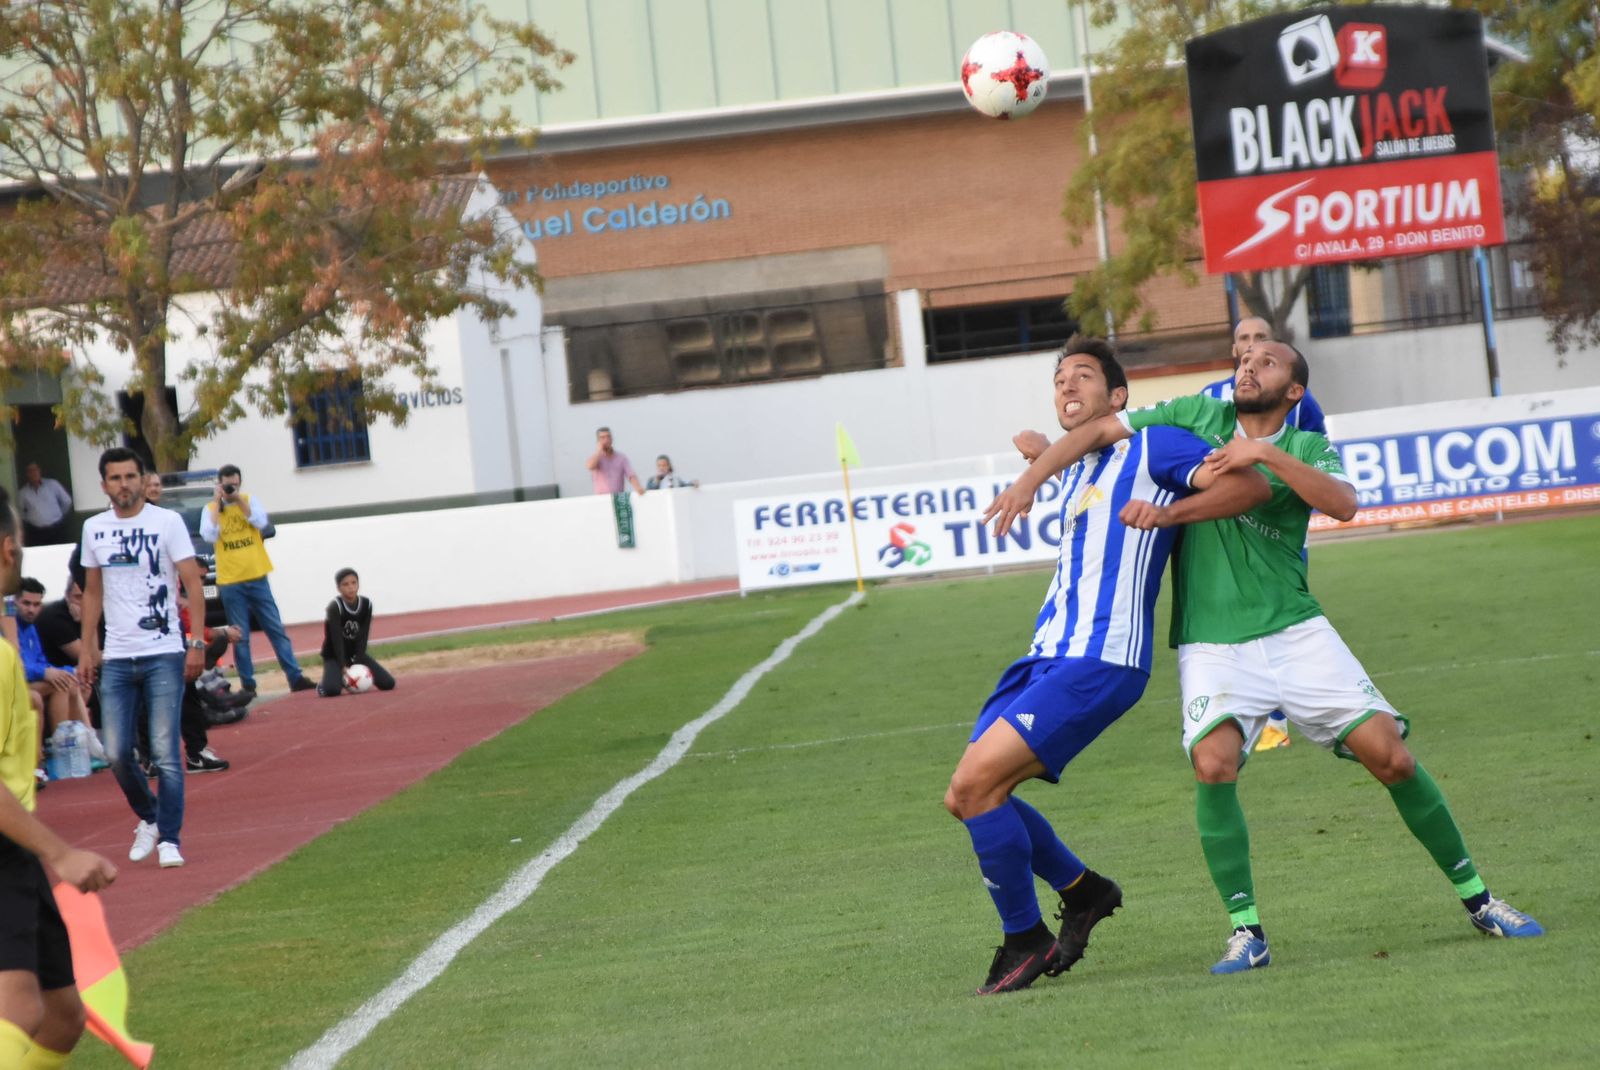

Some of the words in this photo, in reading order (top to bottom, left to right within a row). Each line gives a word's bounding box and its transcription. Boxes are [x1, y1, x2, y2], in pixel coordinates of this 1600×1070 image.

[1351, 30, 1382, 63] K
[1409, 138, 1420, 152] DE
[1422, 134, 1456, 151] JUEGOS
[526, 174, 669, 203] Polideportivo
[524, 208, 573, 241] uel
[582, 195, 731, 235] Calderón
[1223, 177, 1481, 258] SPORTIUM
[1396, 231, 1428, 248] DON
[1431, 224, 1486, 244] BENITO
[398, 387, 463, 409] RVICIOS
[1342, 420, 1577, 491] BLICOM
[1392, 476, 1510, 501] BENITO
[1520, 470, 1577, 488] S.L.
[753, 486, 976, 531] FERRETERIA
[1355, 505, 1427, 523] PEGADA
[1430, 502, 1454, 515] DE
[1457, 491, 1550, 514] CARTELES
[1564, 486, 1600, 501] DISE
